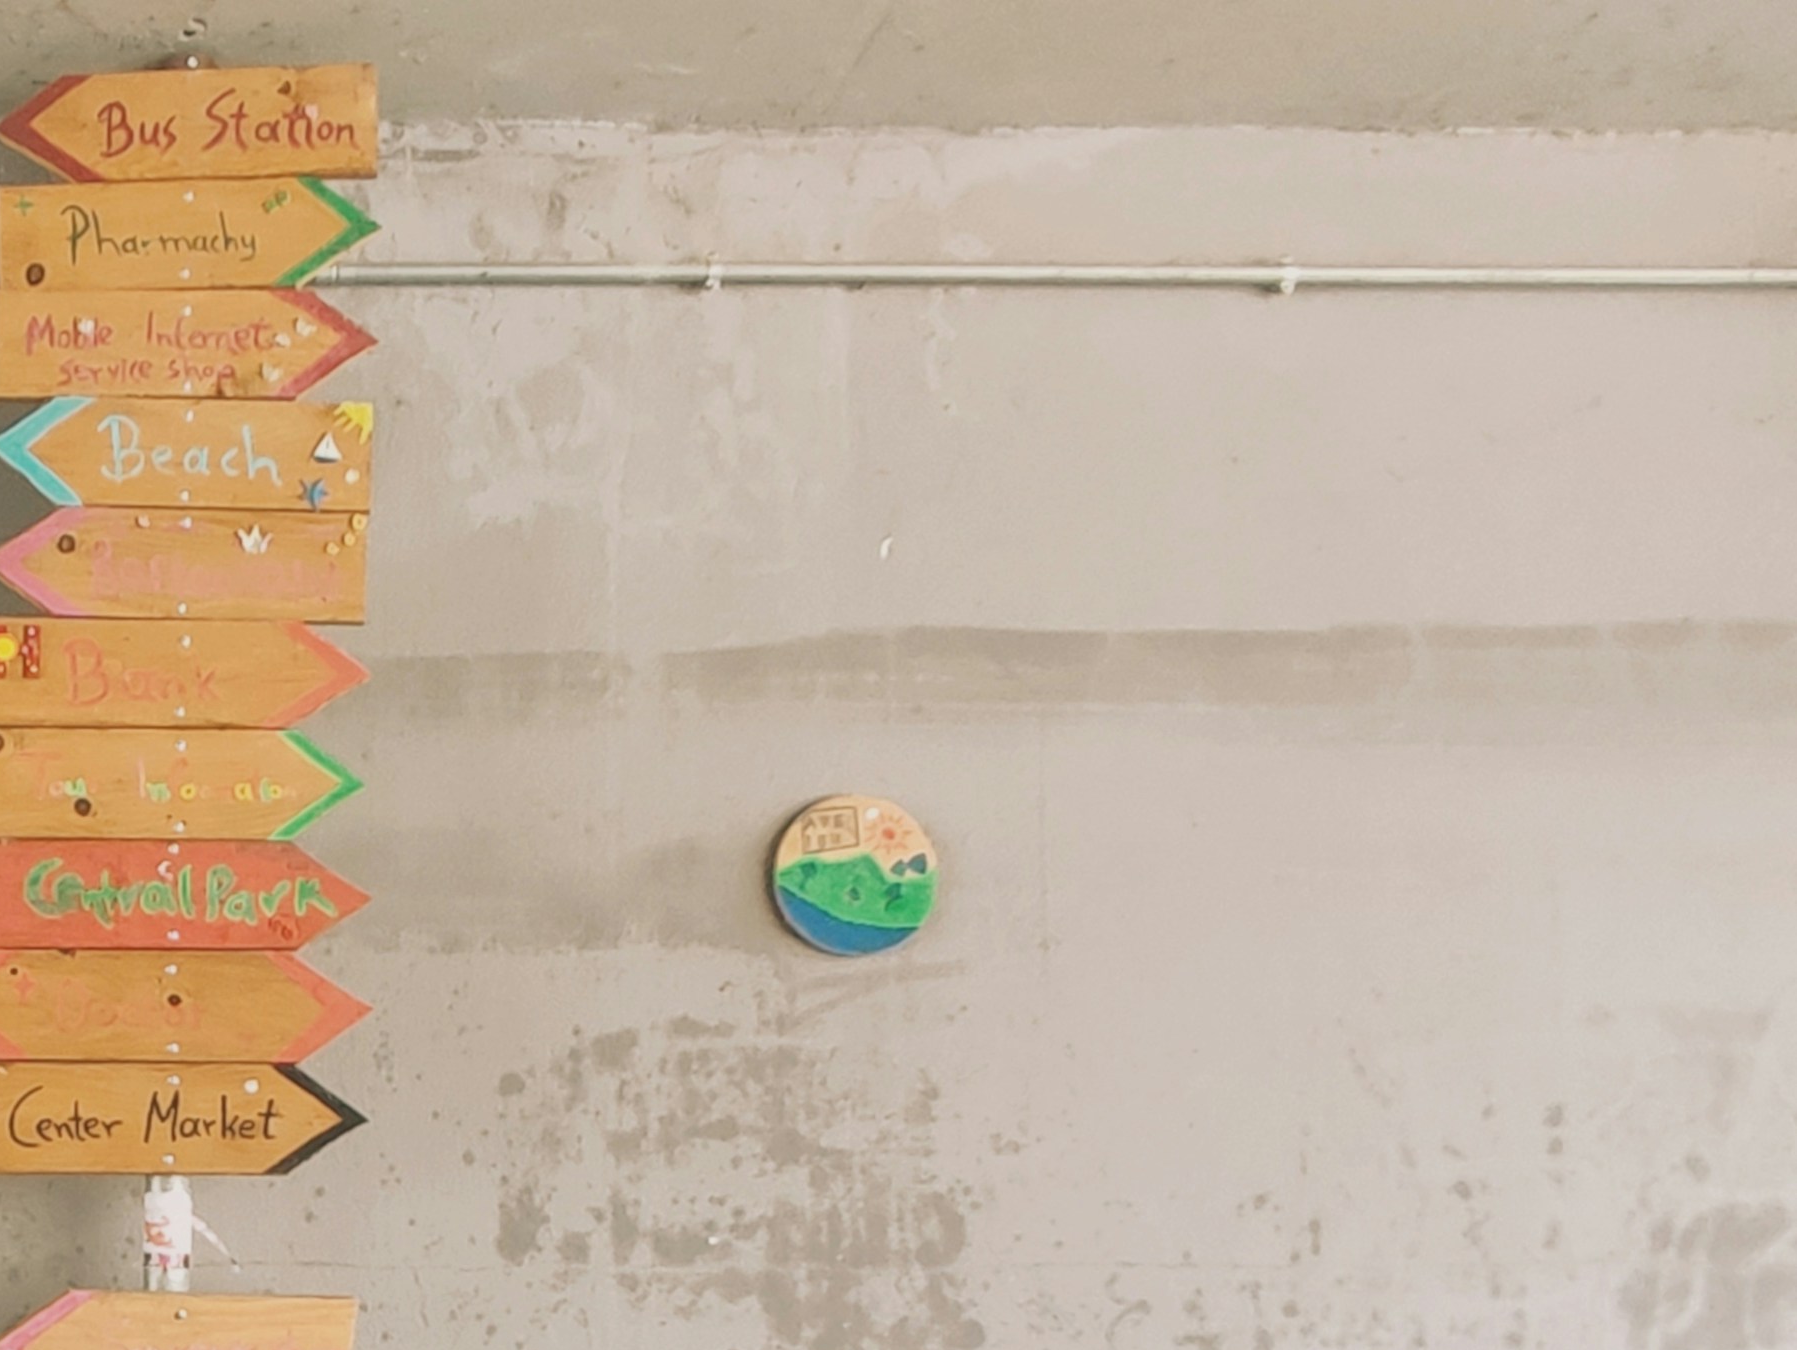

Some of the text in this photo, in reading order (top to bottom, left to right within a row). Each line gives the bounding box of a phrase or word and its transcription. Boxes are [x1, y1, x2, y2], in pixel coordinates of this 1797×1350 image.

[97, 87, 359, 157] Bus Station
[97, 413, 282, 486] Beach
[63, 636, 221, 704] Bank
[23, 857, 196, 928] Central
[8, 1085, 281, 1148] Center Market
